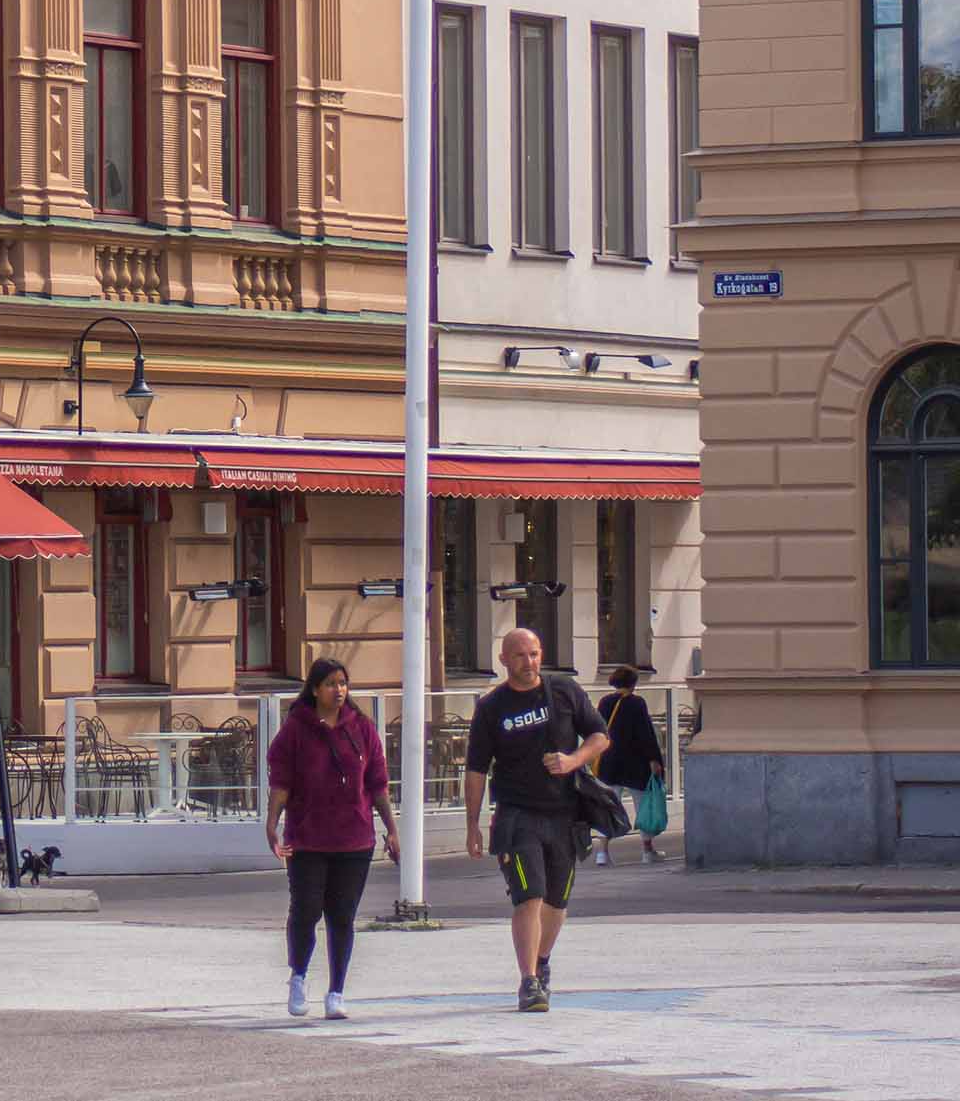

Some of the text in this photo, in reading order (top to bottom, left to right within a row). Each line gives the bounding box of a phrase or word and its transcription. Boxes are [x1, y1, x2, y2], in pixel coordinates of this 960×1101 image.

[716, 282, 764, 296] Kyrkogatan
[15, 464, 64, 477] NAPOLETANA
[220, 469, 297, 483] ITALIAN CASUAL DINING
